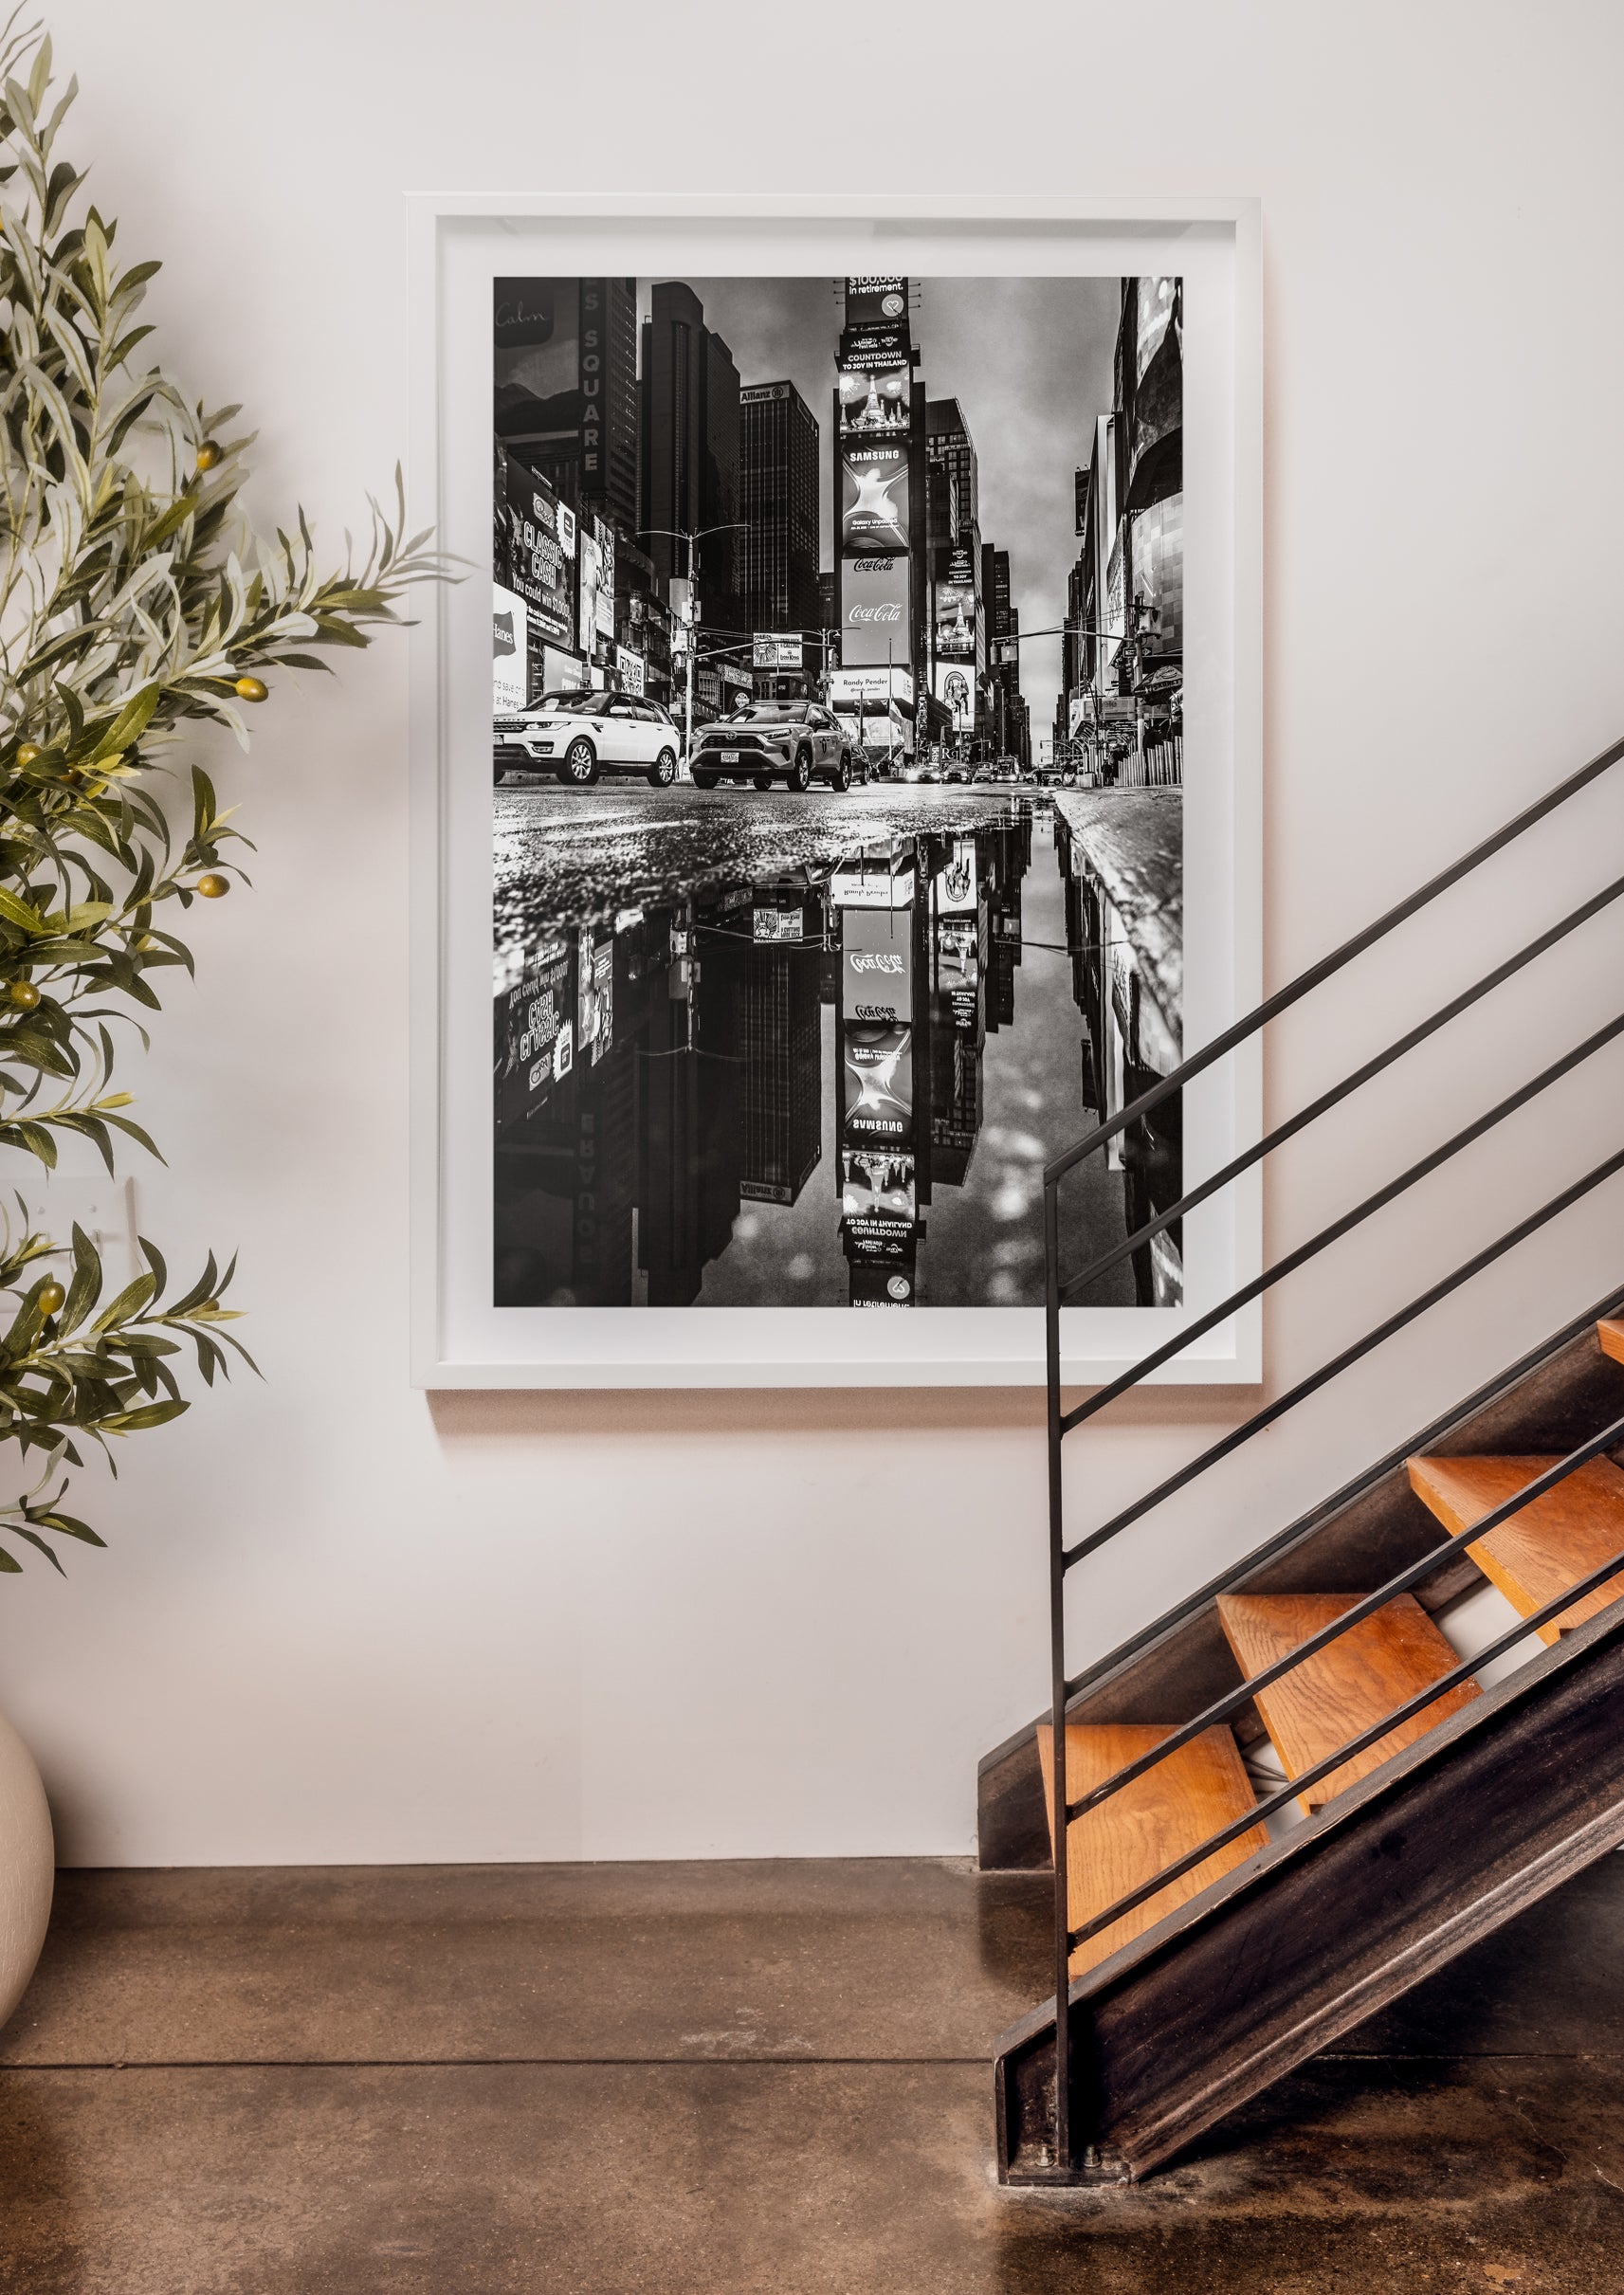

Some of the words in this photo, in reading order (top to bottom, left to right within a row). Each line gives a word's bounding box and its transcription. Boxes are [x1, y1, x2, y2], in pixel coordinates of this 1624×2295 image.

[849, 286, 857, 295] in
[858, 282, 903, 294] retirement.
[495, 301, 547, 327] Calm
[848, 351, 902, 362] COUNTDOWN
[874, 359, 907, 368] THAILAND
[583, 330, 600, 471] SQUARE
[741, 391, 771, 402] Allianz
[849, 450, 900, 462] SAMSUNG
[523, 520, 562, 569] CLASSIC
[532, 553, 557, 590] CASH
[512, 572, 524, 592] You
[525, 584, 541, 602] could
[541, 592, 552, 609] win
